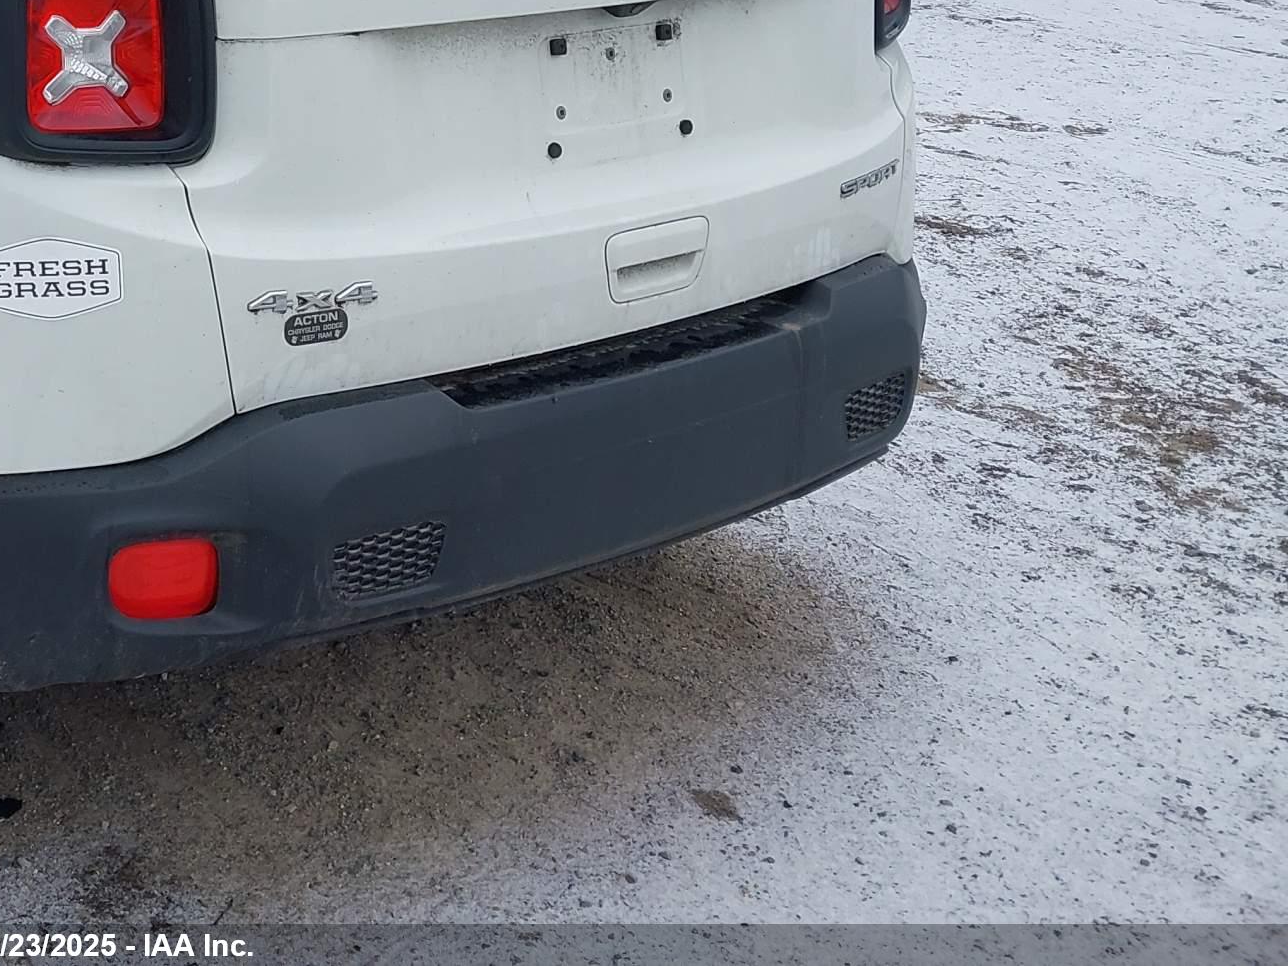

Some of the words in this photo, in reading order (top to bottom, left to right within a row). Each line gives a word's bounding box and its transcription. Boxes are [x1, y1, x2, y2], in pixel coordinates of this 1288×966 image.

[840, 158, 900, 198] SPORT
[294, 311, 338, 327] ACTON
[288, 325, 320, 336] CHRYSLER
[300, 333, 315, 342] JEEP
[318, 331, 333, 340] RAM
